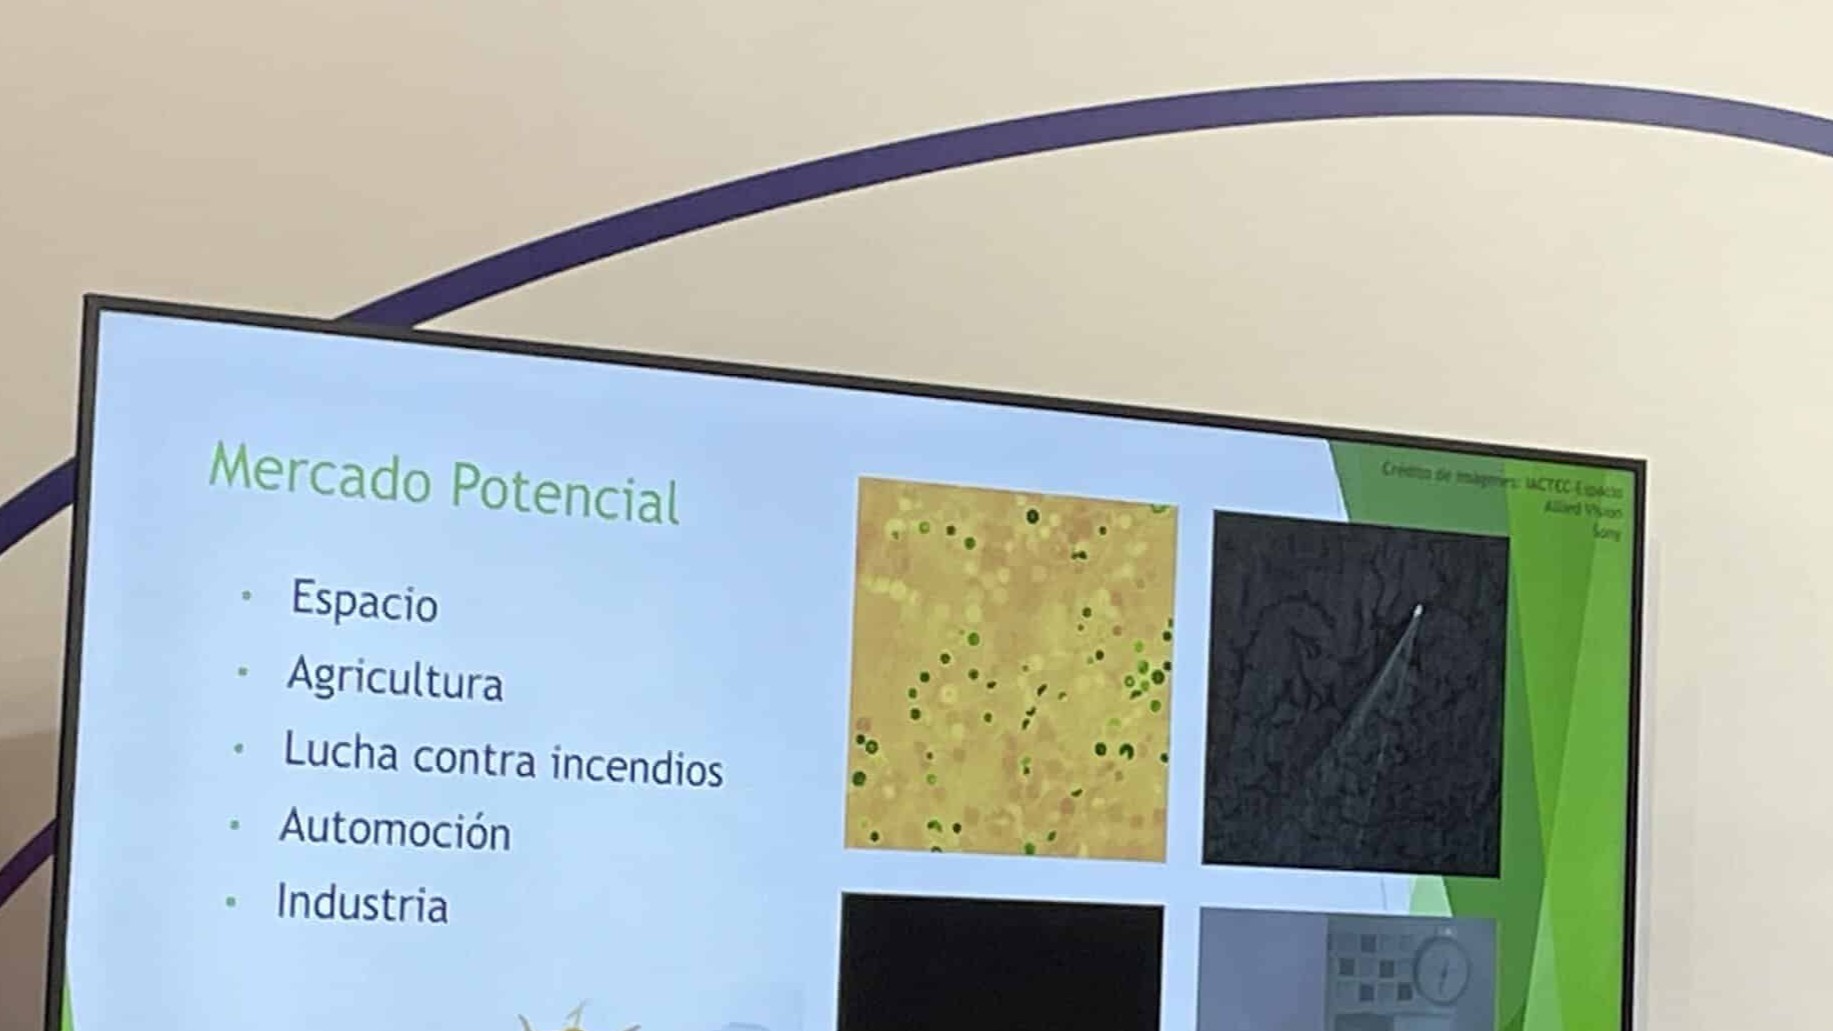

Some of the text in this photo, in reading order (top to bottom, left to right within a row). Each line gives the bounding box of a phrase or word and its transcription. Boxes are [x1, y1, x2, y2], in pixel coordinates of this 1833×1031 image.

[209, 440, 680, 525] Mercado Potencial
[293, 578, 438, 625] Espacio
[287, 654, 504, 702] Agricultura
[284, 730, 724, 788] Lucha contra incendios
[279, 807, 511, 851] Automoción
[277, 882, 448, 924] Industria
